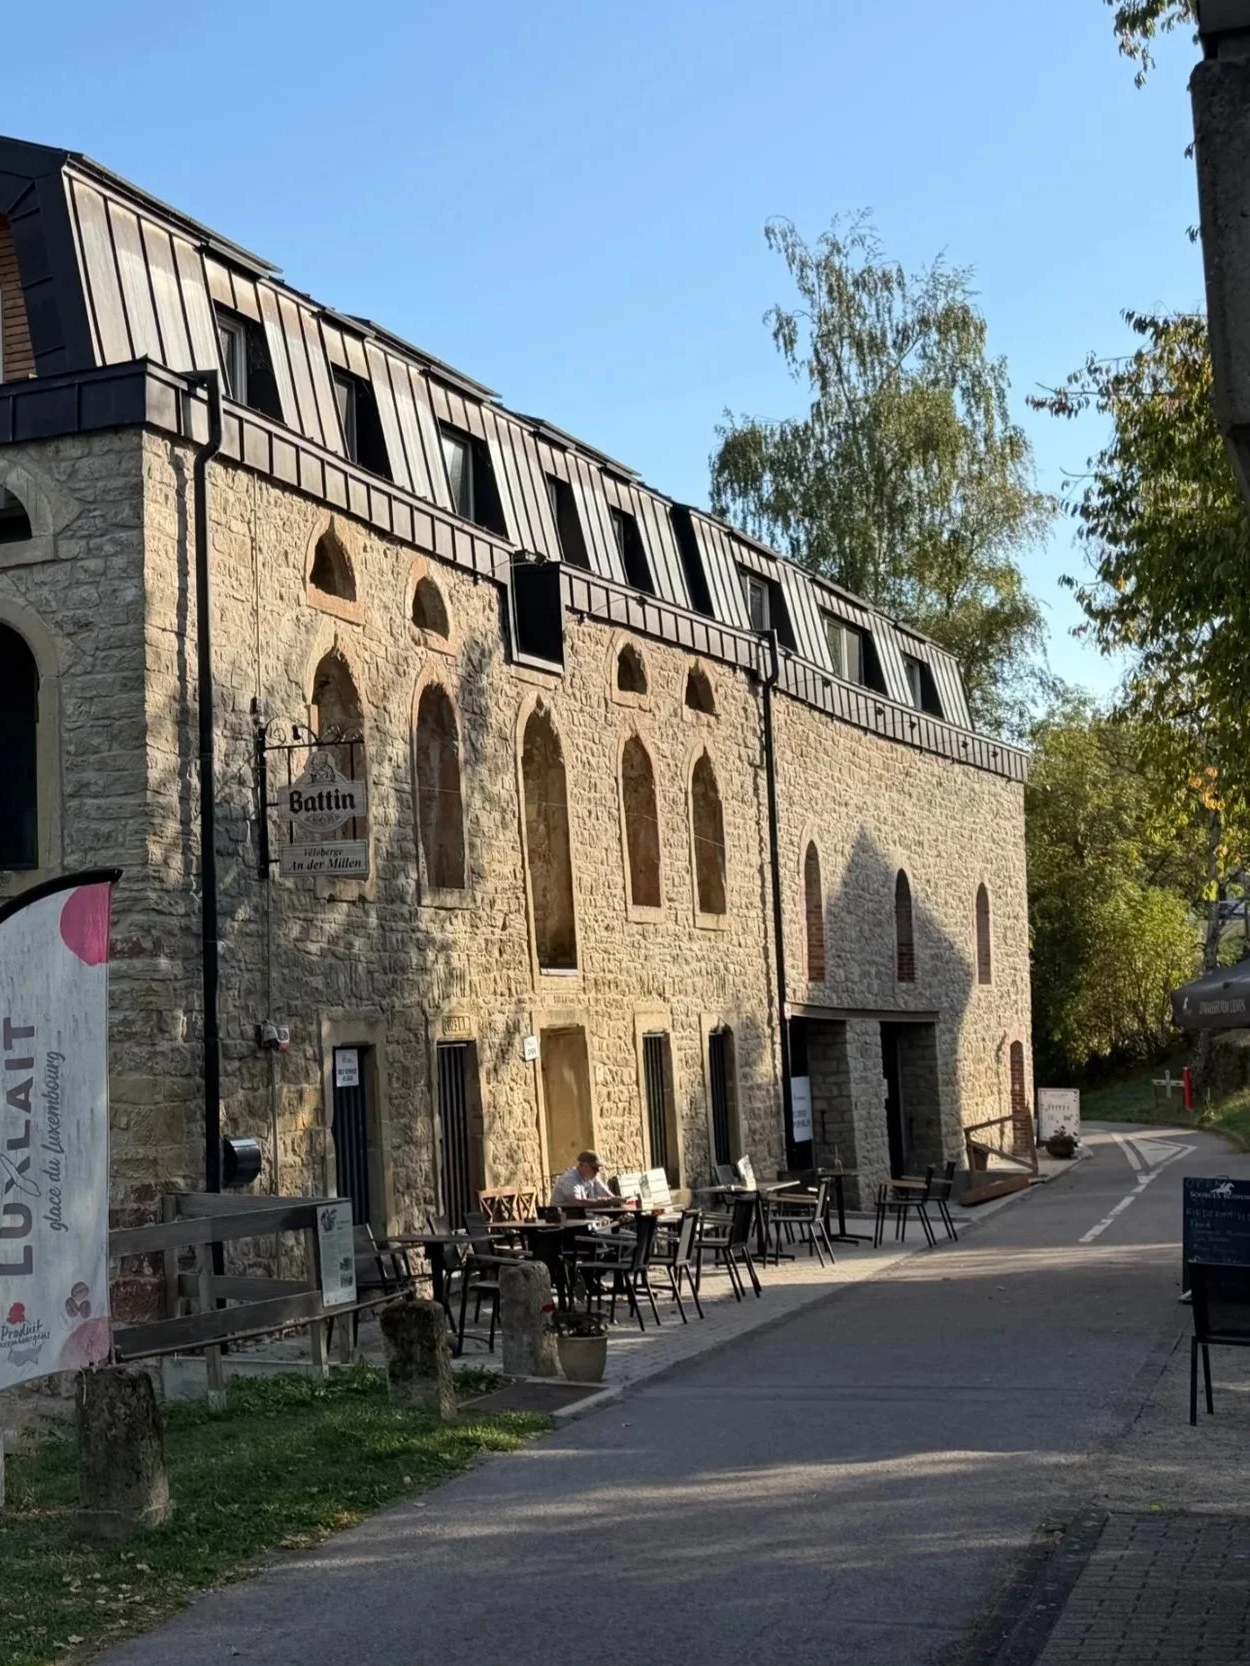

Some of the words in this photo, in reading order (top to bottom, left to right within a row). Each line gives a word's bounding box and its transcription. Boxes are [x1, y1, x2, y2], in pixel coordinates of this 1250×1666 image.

[289, 788, 356, 814] Battin
[307, 859, 324, 870] der
[328, 857, 361, 869] Millen
[41, 1051, 67, 1154] Luxembourg
[42, 1156, 61, 1182] du
[43, 1186, 69, 1233] glace
[1, 1319, 43, 1341] Produit
